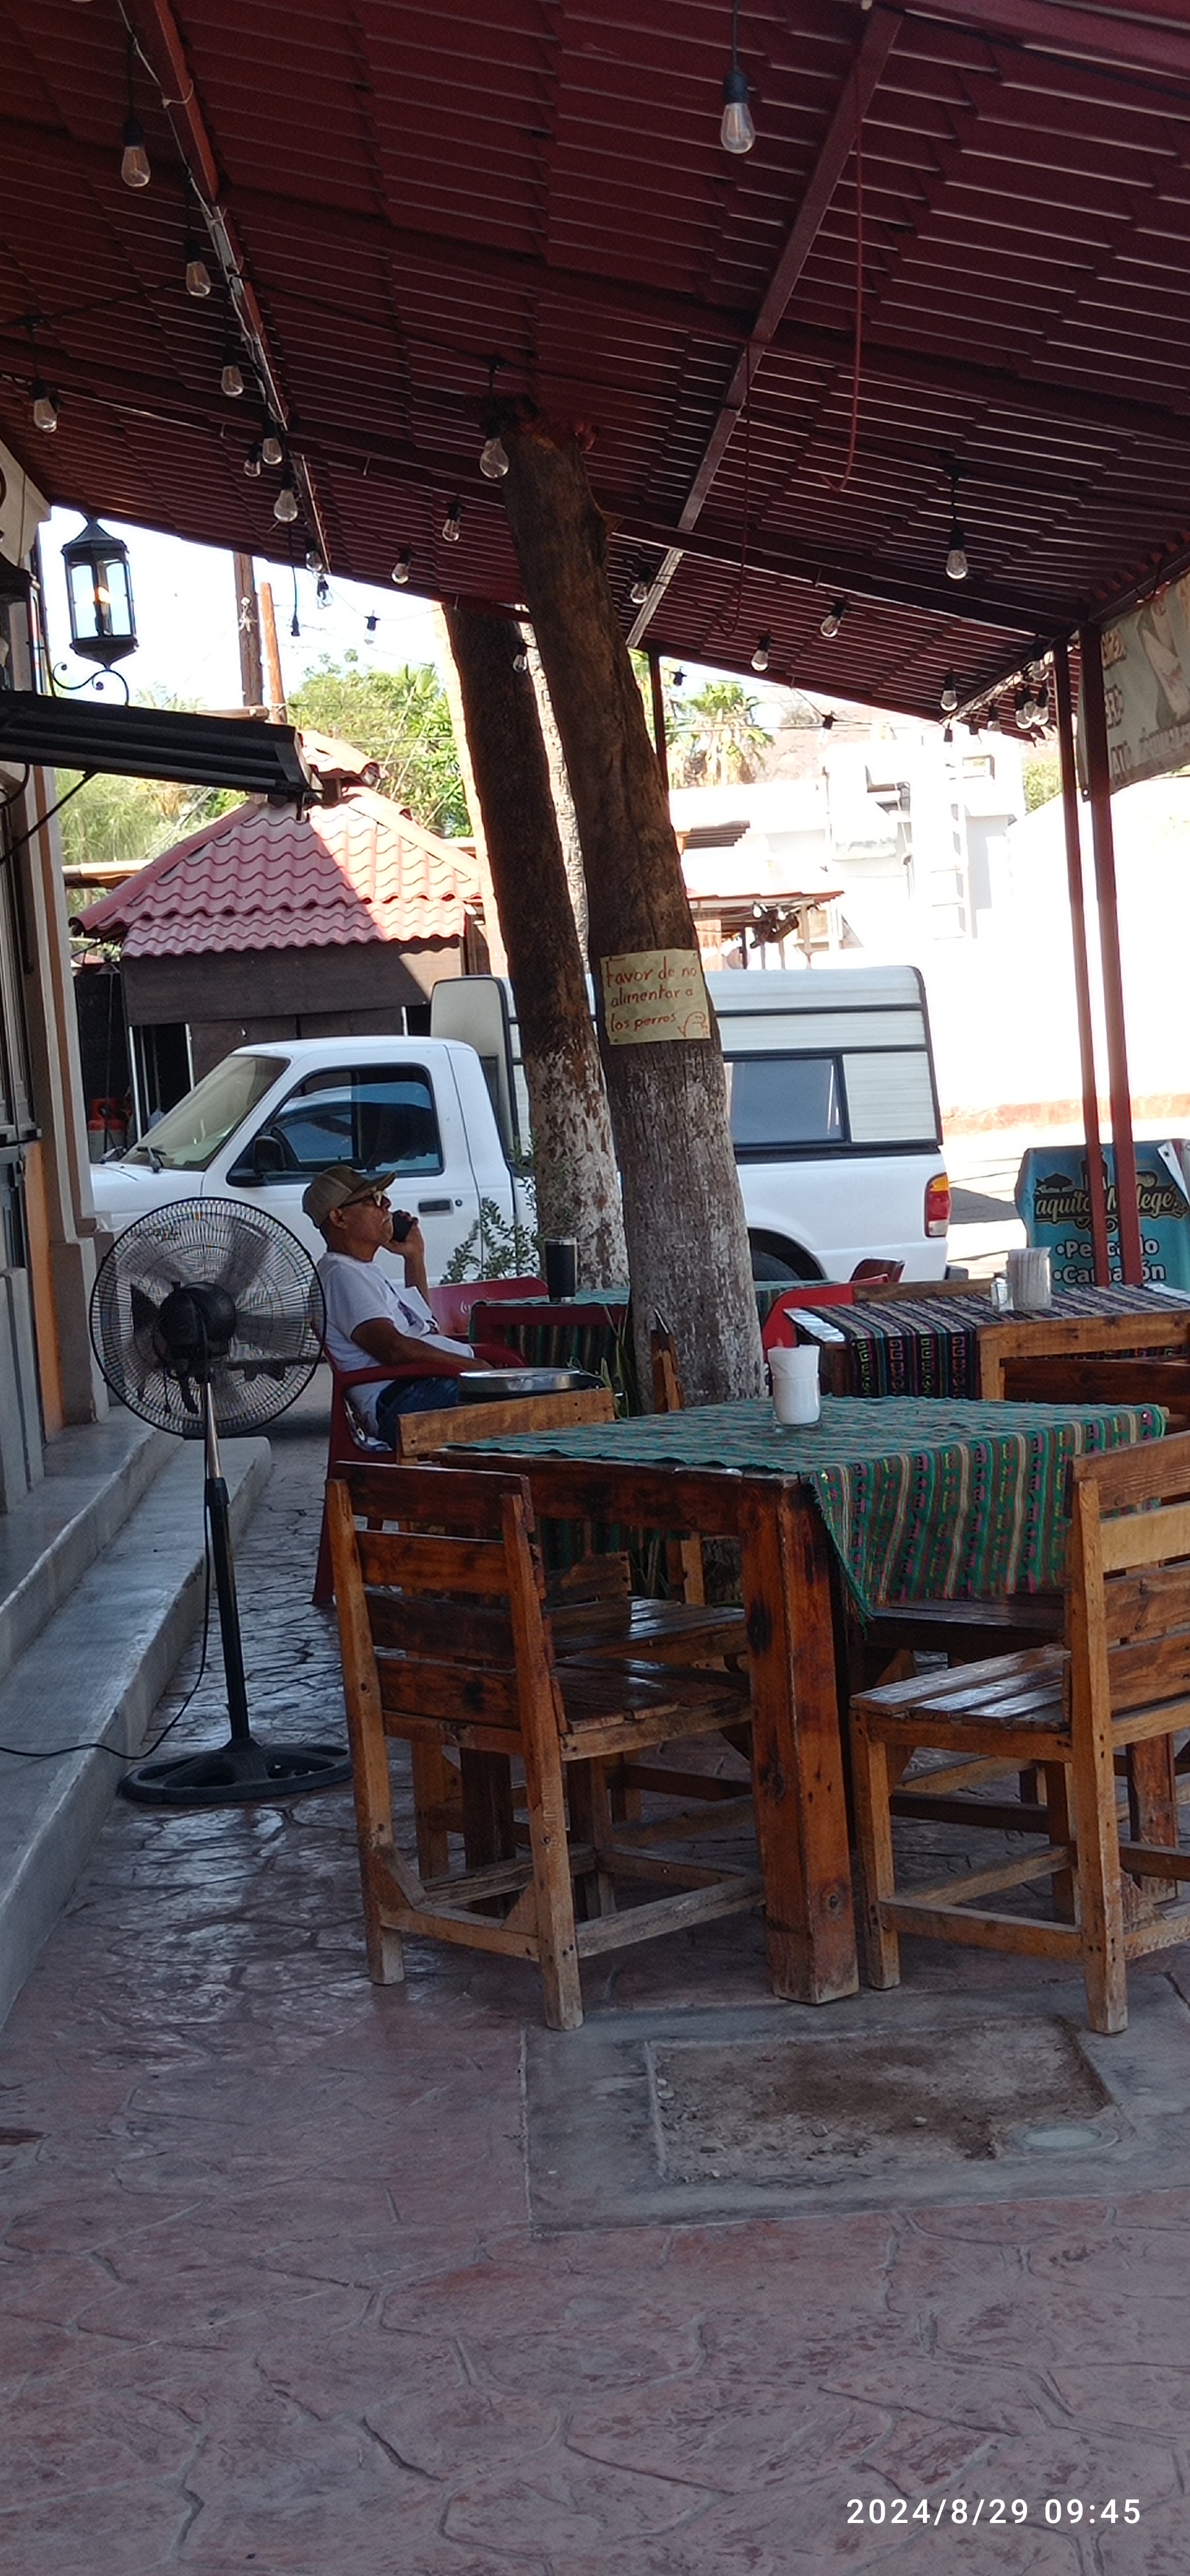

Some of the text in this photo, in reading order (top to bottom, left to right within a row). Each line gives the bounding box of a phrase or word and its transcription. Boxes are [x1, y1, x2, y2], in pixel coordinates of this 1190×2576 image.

[605, 956, 697, 987] Favor de no
[611, 985, 680, 1008] alimentar
[611, 1012, 676, 1032] los perros
[1107, 1185, 1176, 1216] Mlegé
